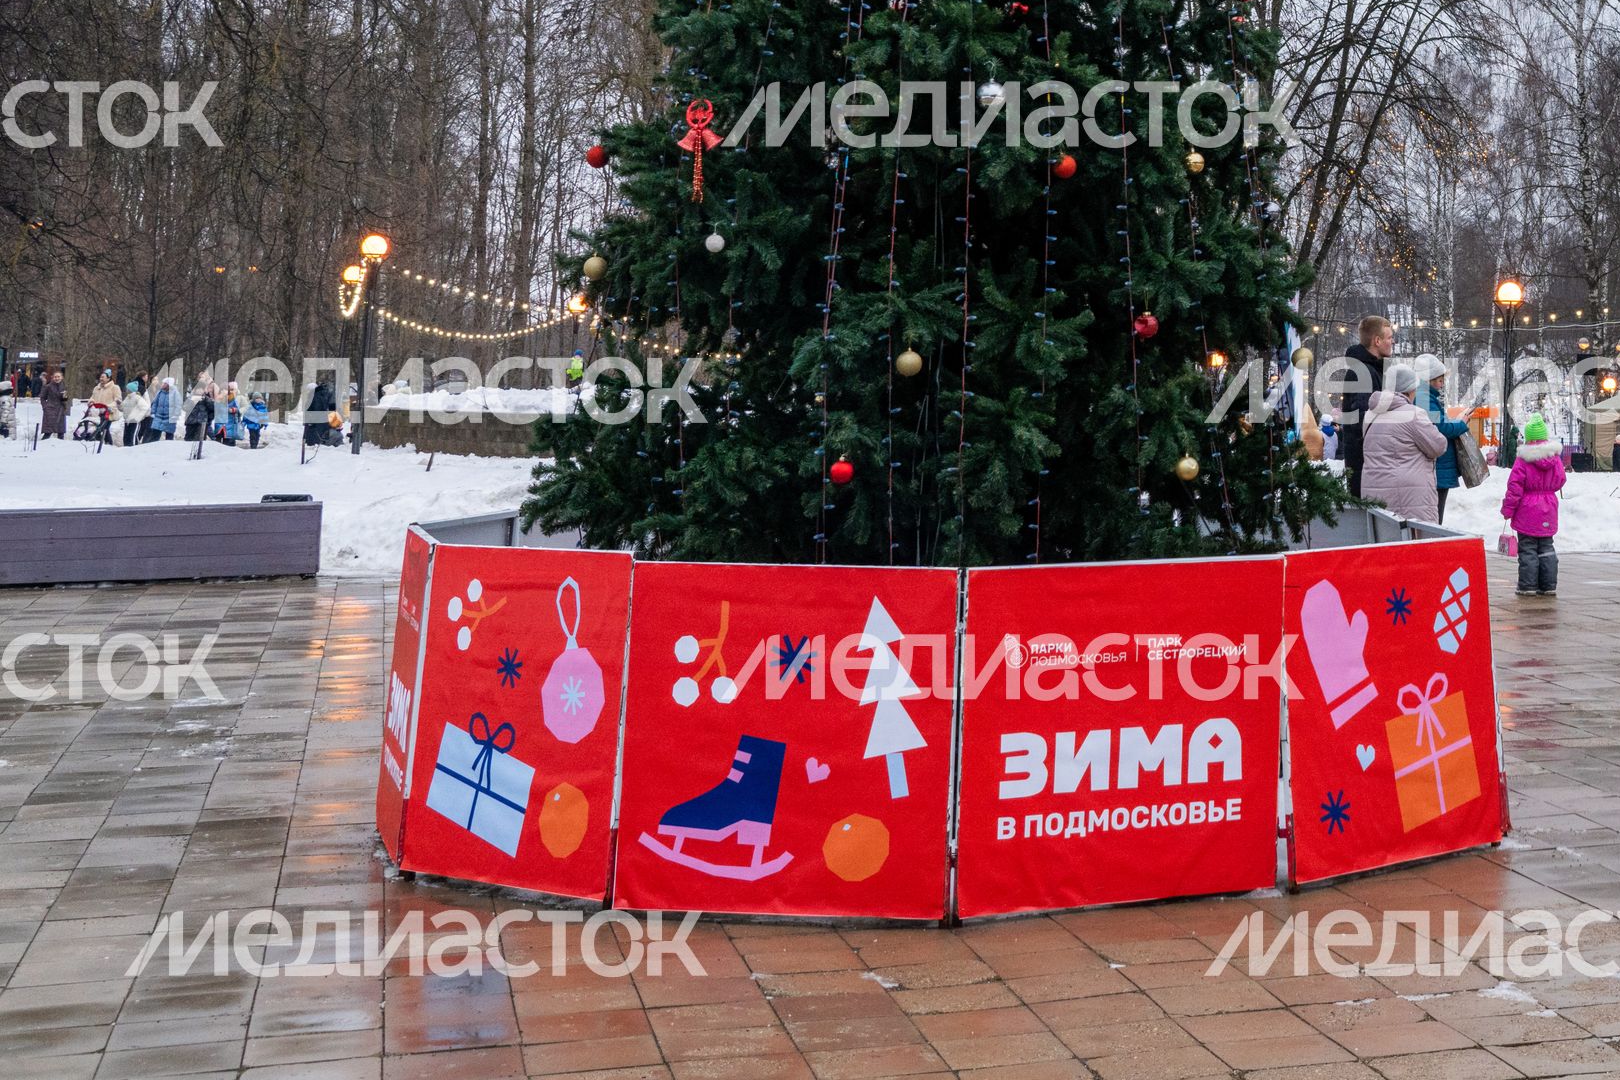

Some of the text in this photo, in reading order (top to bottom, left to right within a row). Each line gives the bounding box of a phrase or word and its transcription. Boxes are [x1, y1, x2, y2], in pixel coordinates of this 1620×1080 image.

[1030, 642, 1072, 655] ПАРКИ
[1147, 636, 1182, 648] ПАРК
[1030, 651, 1127, 667] ПОДМОСКОВЬЯ
[1146, 642, 1248, 661] СЕСТРОРЕЦКИЙ
[998, 717, 1243, 800] ЗИМА
[997, 798, 1242, 840] В ПОДМОСКОВЬЕ
